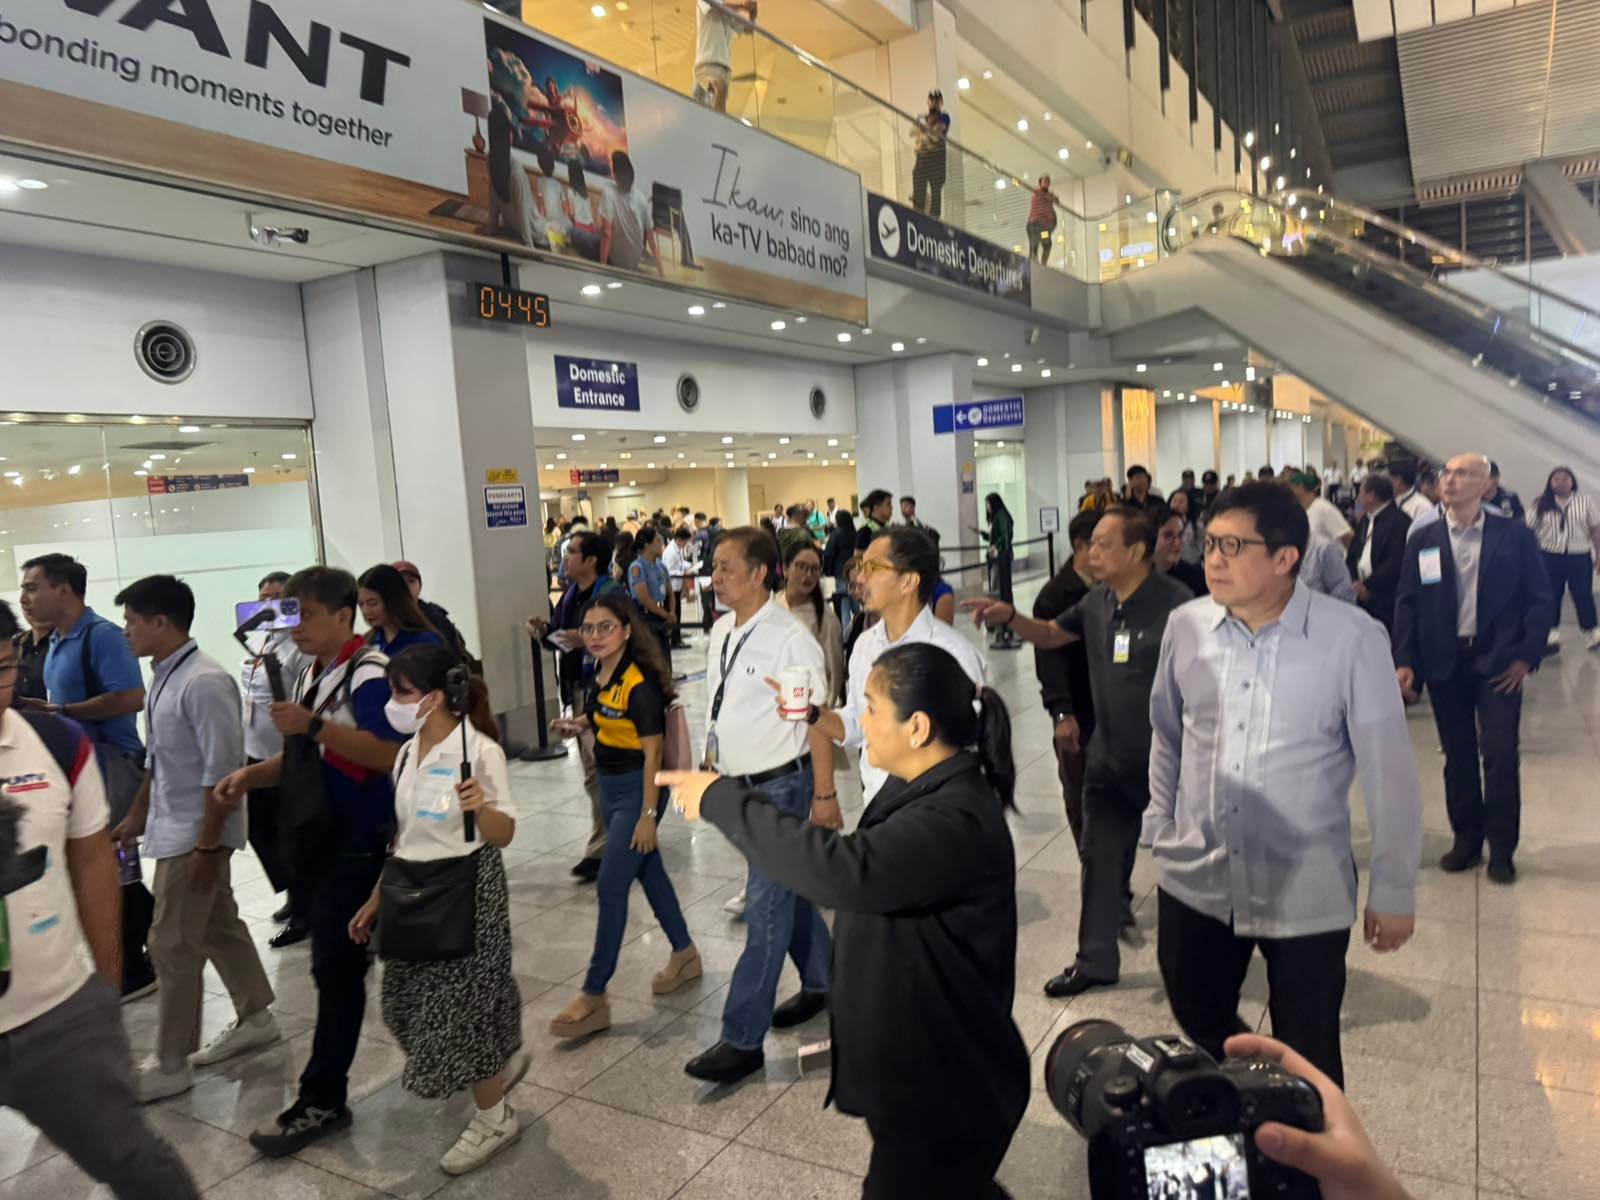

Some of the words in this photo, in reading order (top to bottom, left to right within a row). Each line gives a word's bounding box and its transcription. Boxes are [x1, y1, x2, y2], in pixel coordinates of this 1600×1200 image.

[0, 13, 141, 83] bonding
[151, 64, 285, 119] moments
[293, 101, 393, 147] together
[64, 0, 411, 106] ANT
[702, 143, 784, 228] Ikaw,
[790, 206, 821, 238] sino
[824, 222, 850, 252] ang
[711, 212, 762, 253] ka-TV
[766, 230, 816, 270] babad
[819, 253, 848, 278] mo?
[906, 221, 966, 271] Domestic
[968, 246, 1023, 292] Departures
[569, 363, 626, 385] Domestic
[573, 387, 625, 407] Entrance
